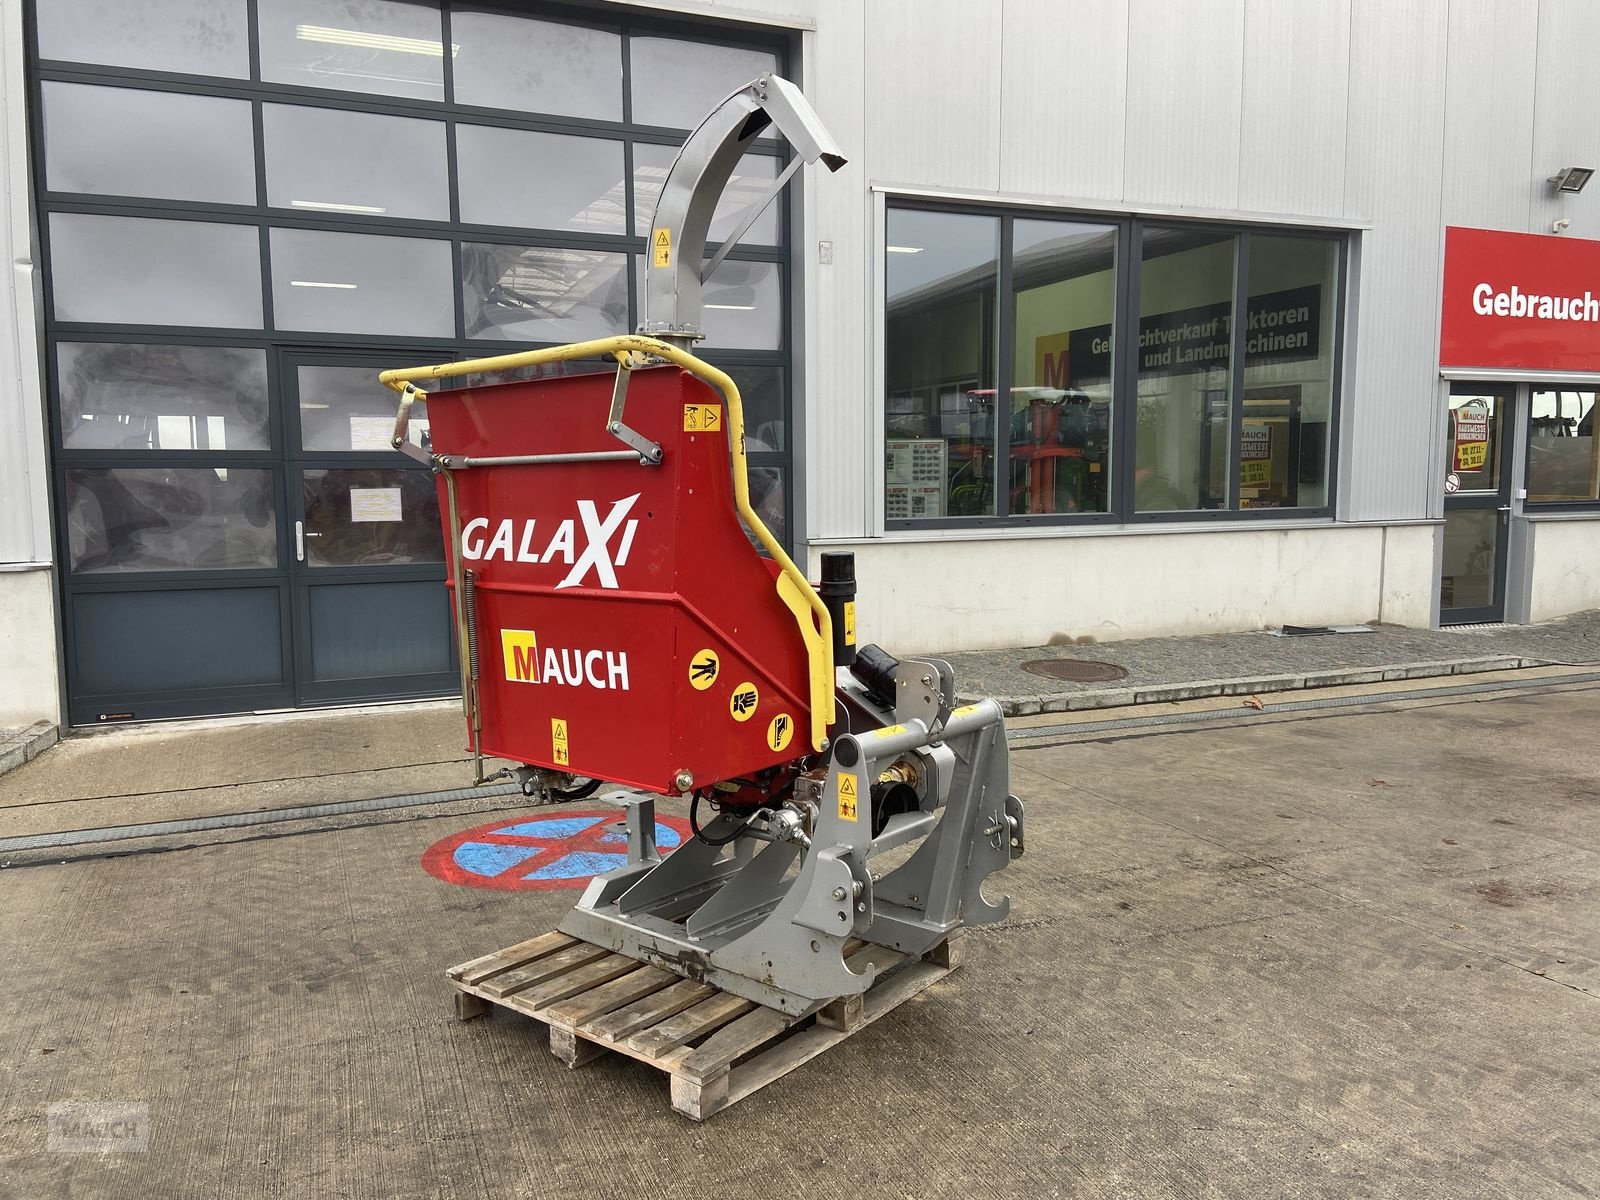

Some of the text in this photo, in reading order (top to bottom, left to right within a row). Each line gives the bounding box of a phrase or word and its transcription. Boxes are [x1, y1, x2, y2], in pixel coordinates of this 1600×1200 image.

[1473, 283, 1600, 322] Gebrauch
[1092, 306, 1309, 354] Gechtverkauf Tktoren
[1144, 330, 1308, 368] und Landmchinen
[461, 492, 642, 590] GALAXI
[512, 645, 630, 690] MAUCH
